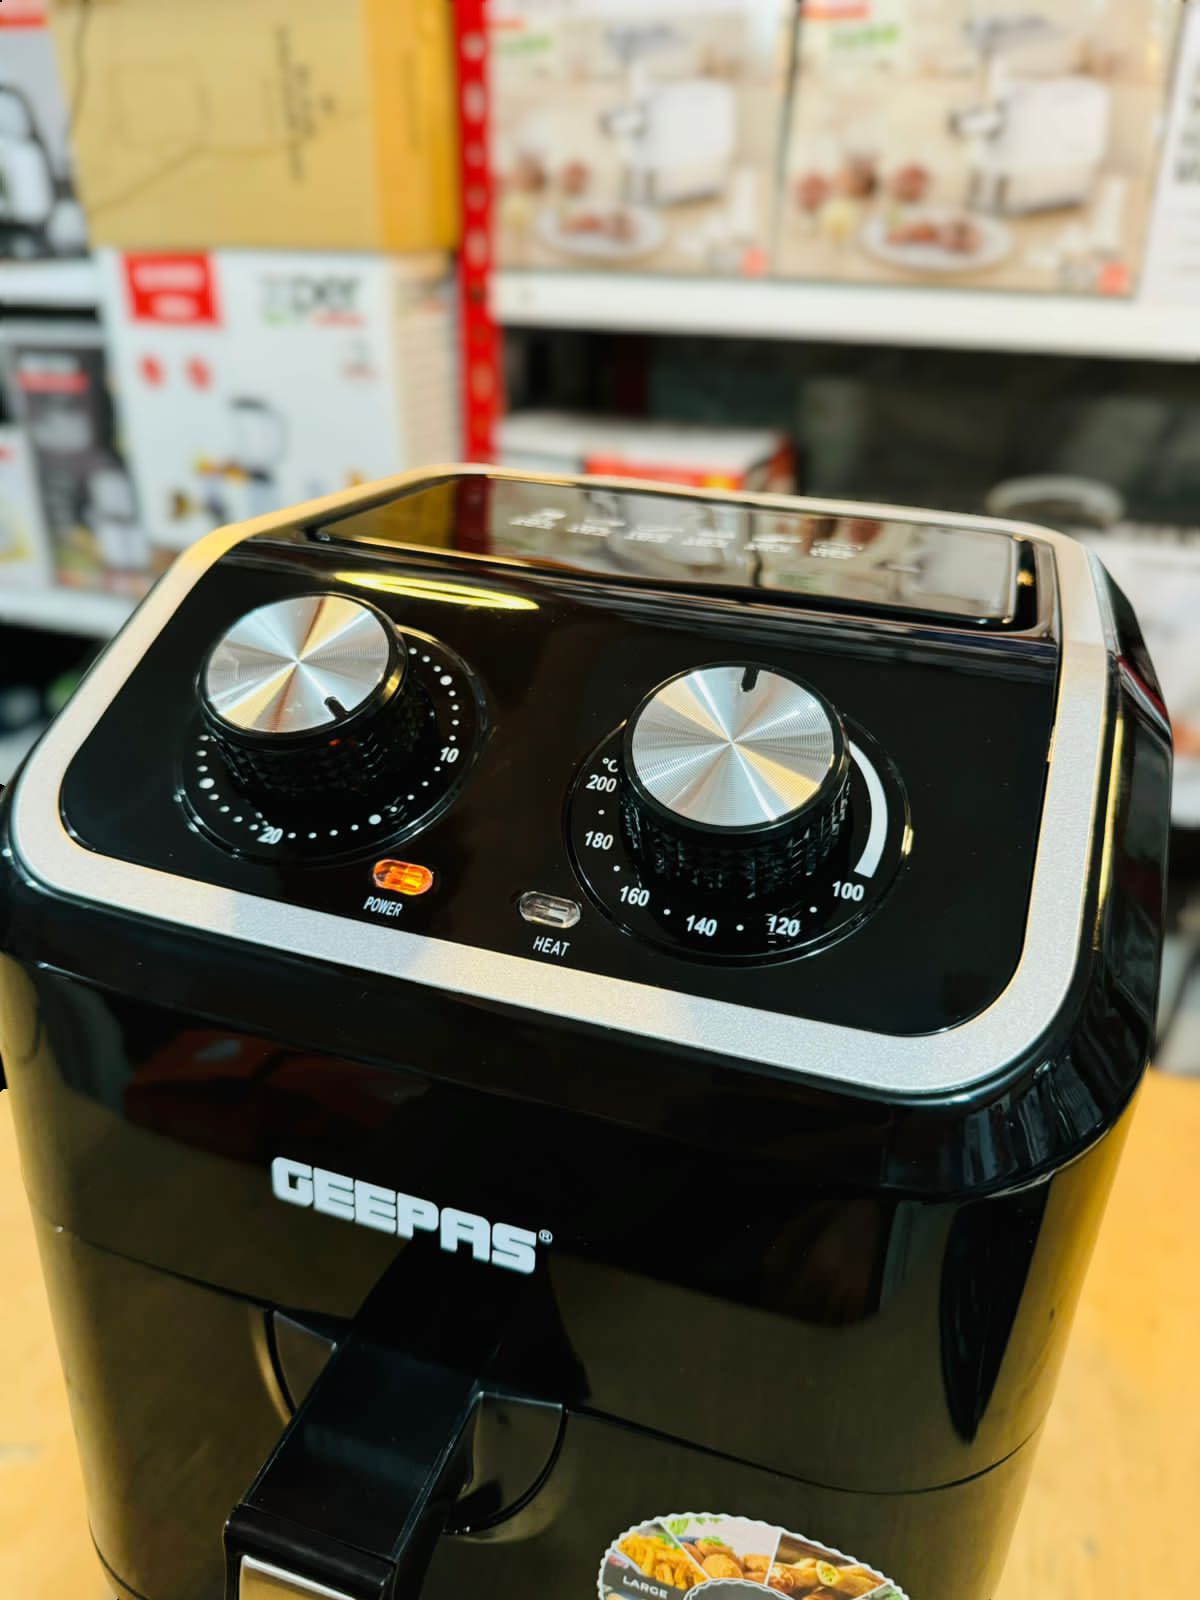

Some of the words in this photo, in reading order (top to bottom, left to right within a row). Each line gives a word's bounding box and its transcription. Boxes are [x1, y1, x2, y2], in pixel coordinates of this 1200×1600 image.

[440, 747, 460, 763] 10
[585, 774, 617, 793] 200
[257, 826, 284, 844] 20
[584, 830, 614, 850] 180
[619, 884, 650, 907] 160
[832, 880, 865, 902] 100
[363, 896, 403, 917] POWER
[686, 914, 718, 937] 140
[767, 914, 801, 937] 120
[532, 935, 571, 957] HEAT
[622, 1575, 668, 1599] LARGE
